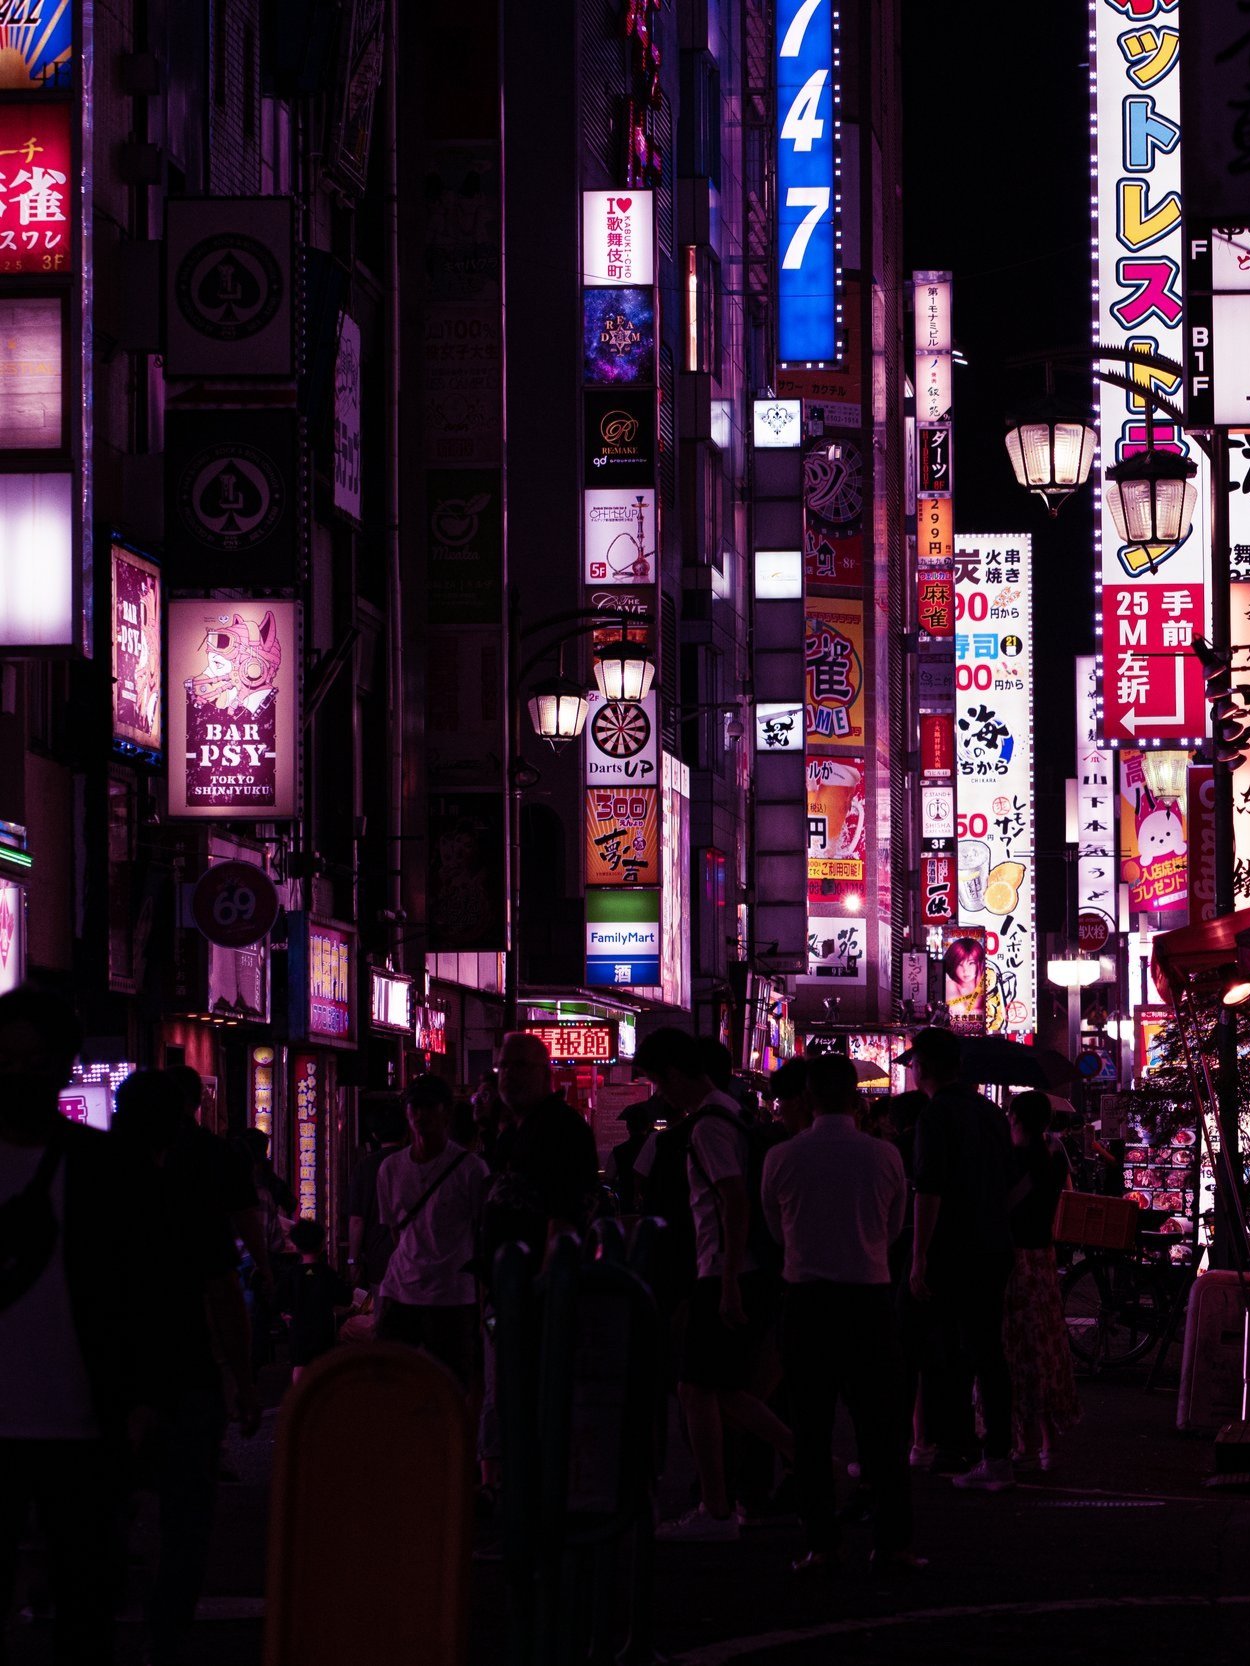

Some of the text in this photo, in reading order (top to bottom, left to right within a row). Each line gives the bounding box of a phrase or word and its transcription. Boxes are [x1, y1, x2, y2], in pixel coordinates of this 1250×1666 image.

[0, 166, 67, 226] 雀
[607, 216, 624, 280] 歌舞伎町
[624, 215, 632, 279] KABUKI-CHO
[42, 254, 64, 270] 3F
[927, 287, 940, 348] 第1モナミビル
[931, 430, 948, 479] ダーツ
[928, 498, 942, 555] 299円
[591, 563, 606, 577] 5F
[122, 601, 137, 624] BAR
[920, 582, 951, 629] 麻雀
[990, 607, 1020, 620] 円から
[1161, 590, 1193, 647] 手前
[1005, 635, 1018, 646] 21
[994, 679, 1024, 691] 円から
[589, 693, 600, 702] 2F
[205, 723, 261, 741] BAR
[199, 744, 268, 767] PSY
[974, 747, 986, 758] の
[589, 762, 623, 774] Darts
[960, 760, 1009, 776] ちから
[210, 775, 255, 785] TOKYO
[194, 786, 271, 796] SHINJYUKU
[596, 793, 647, 820] 300
[1011, 794, 1027, 838] レモン
[931, 839, 946, 850] 3F
[987, 833, 995, 841] 円
[212, 887, 257, 926] 69
[591, 932, 655, 945] FamilyMart
[614, 964, 632, 983] 酒
